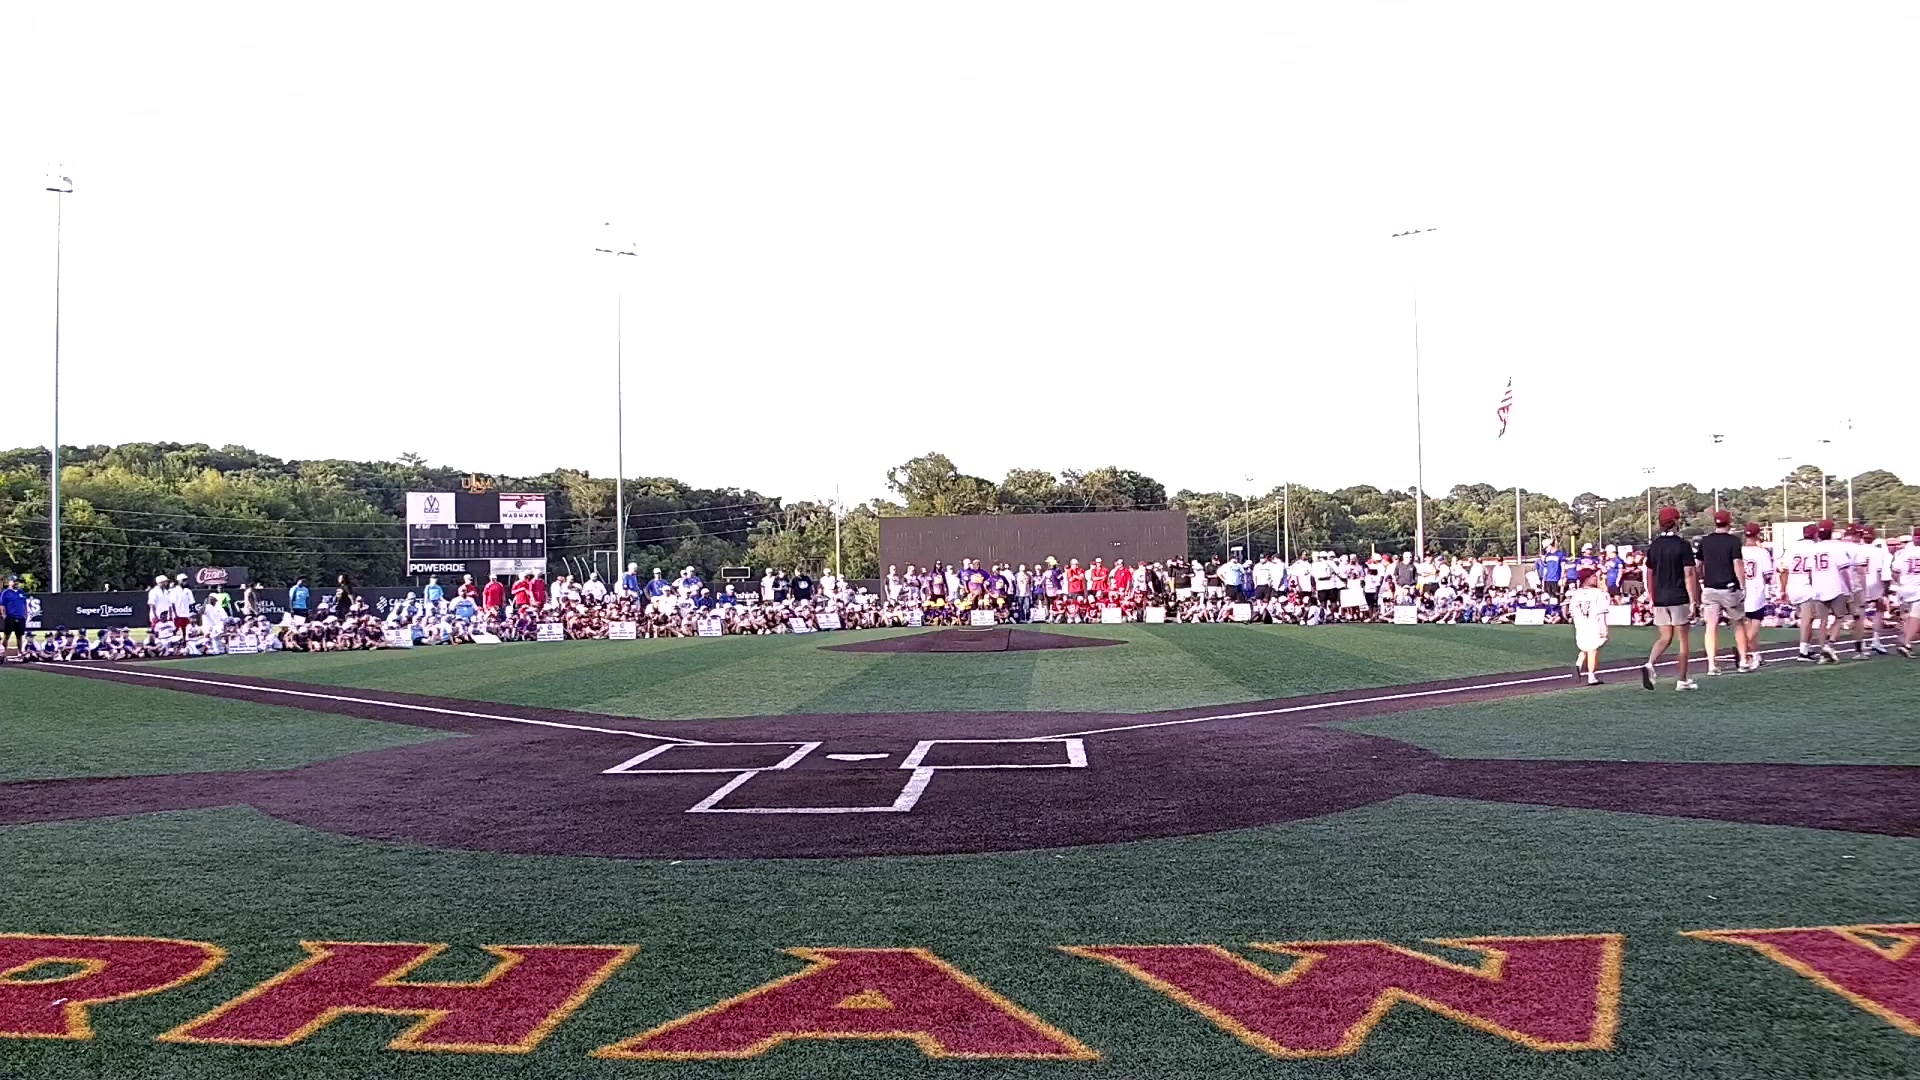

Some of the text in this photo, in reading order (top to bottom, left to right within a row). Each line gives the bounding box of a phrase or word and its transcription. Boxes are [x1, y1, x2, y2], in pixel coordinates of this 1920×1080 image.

[1814, 552, 1829, 571] 16
[409, 563, 466, 573] POWERADE
[76, 606, 101, 615] Super
